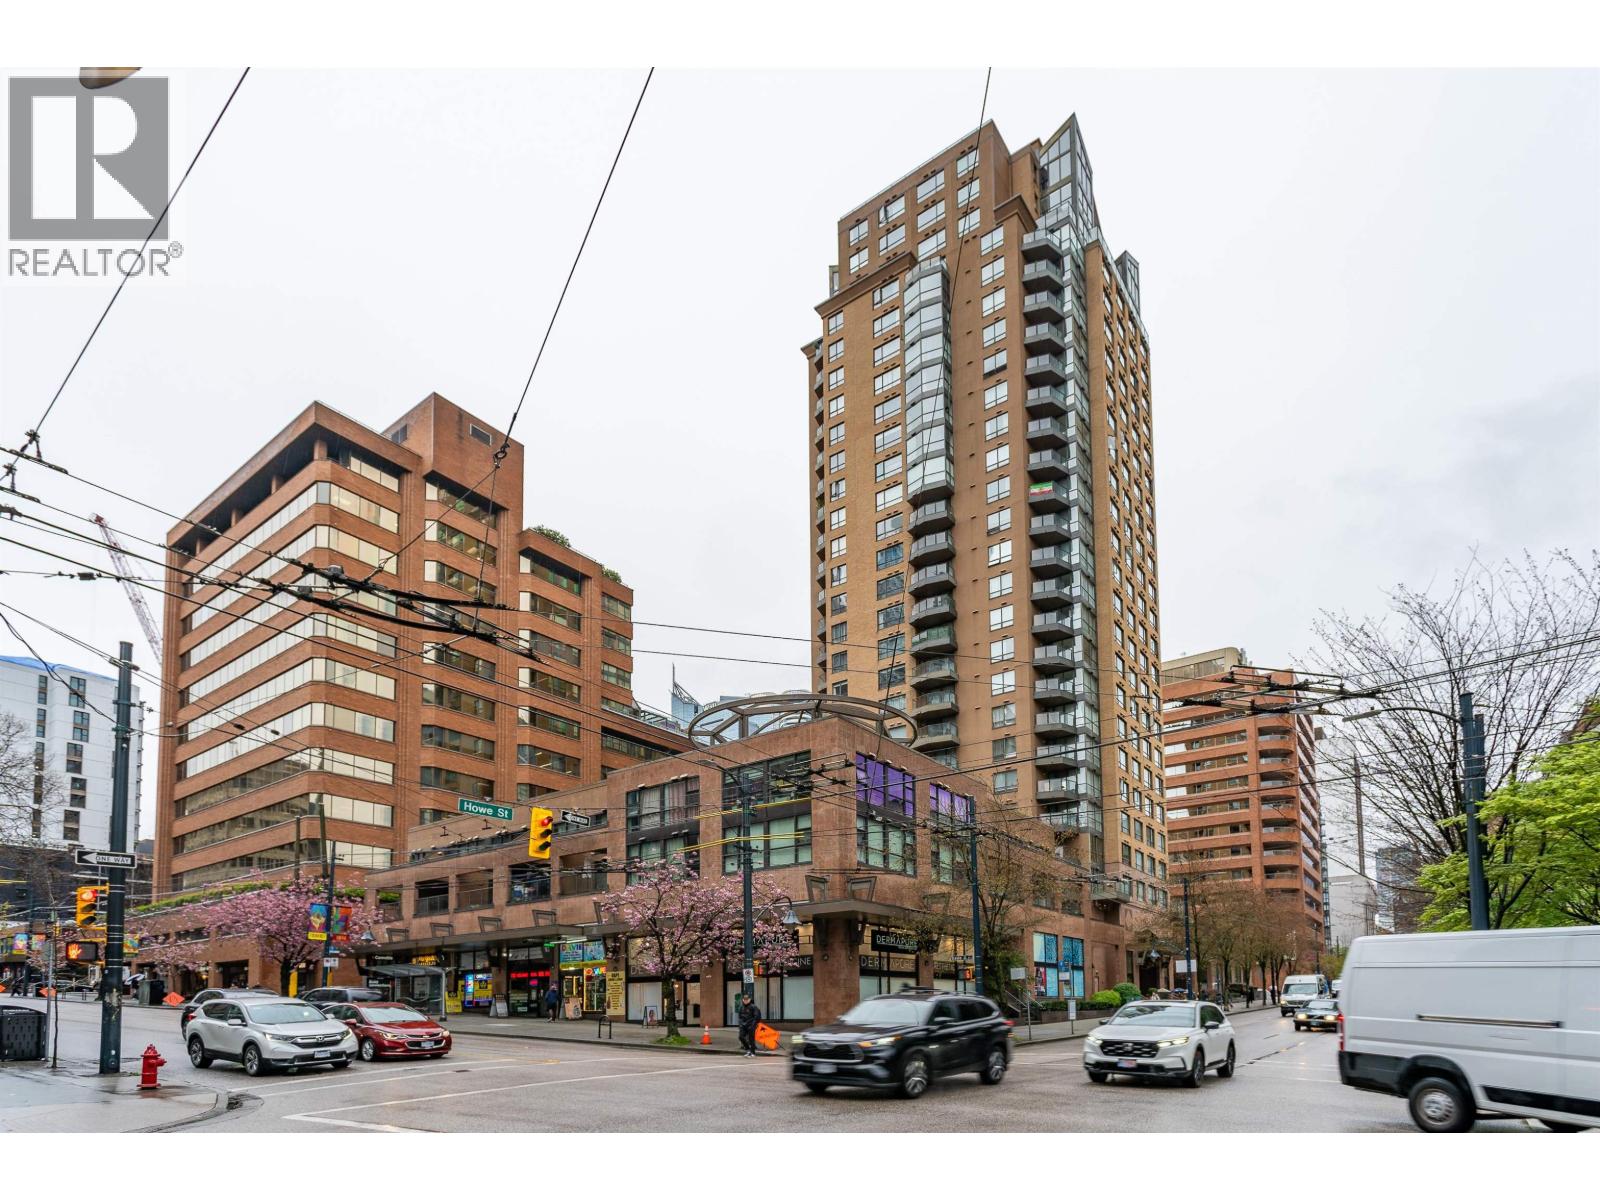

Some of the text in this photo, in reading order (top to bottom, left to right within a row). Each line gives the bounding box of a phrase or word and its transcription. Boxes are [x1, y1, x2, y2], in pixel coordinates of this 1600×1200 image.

[463, 801, 509, 818] Howe St
[96, 855, 110, 863] ONE
